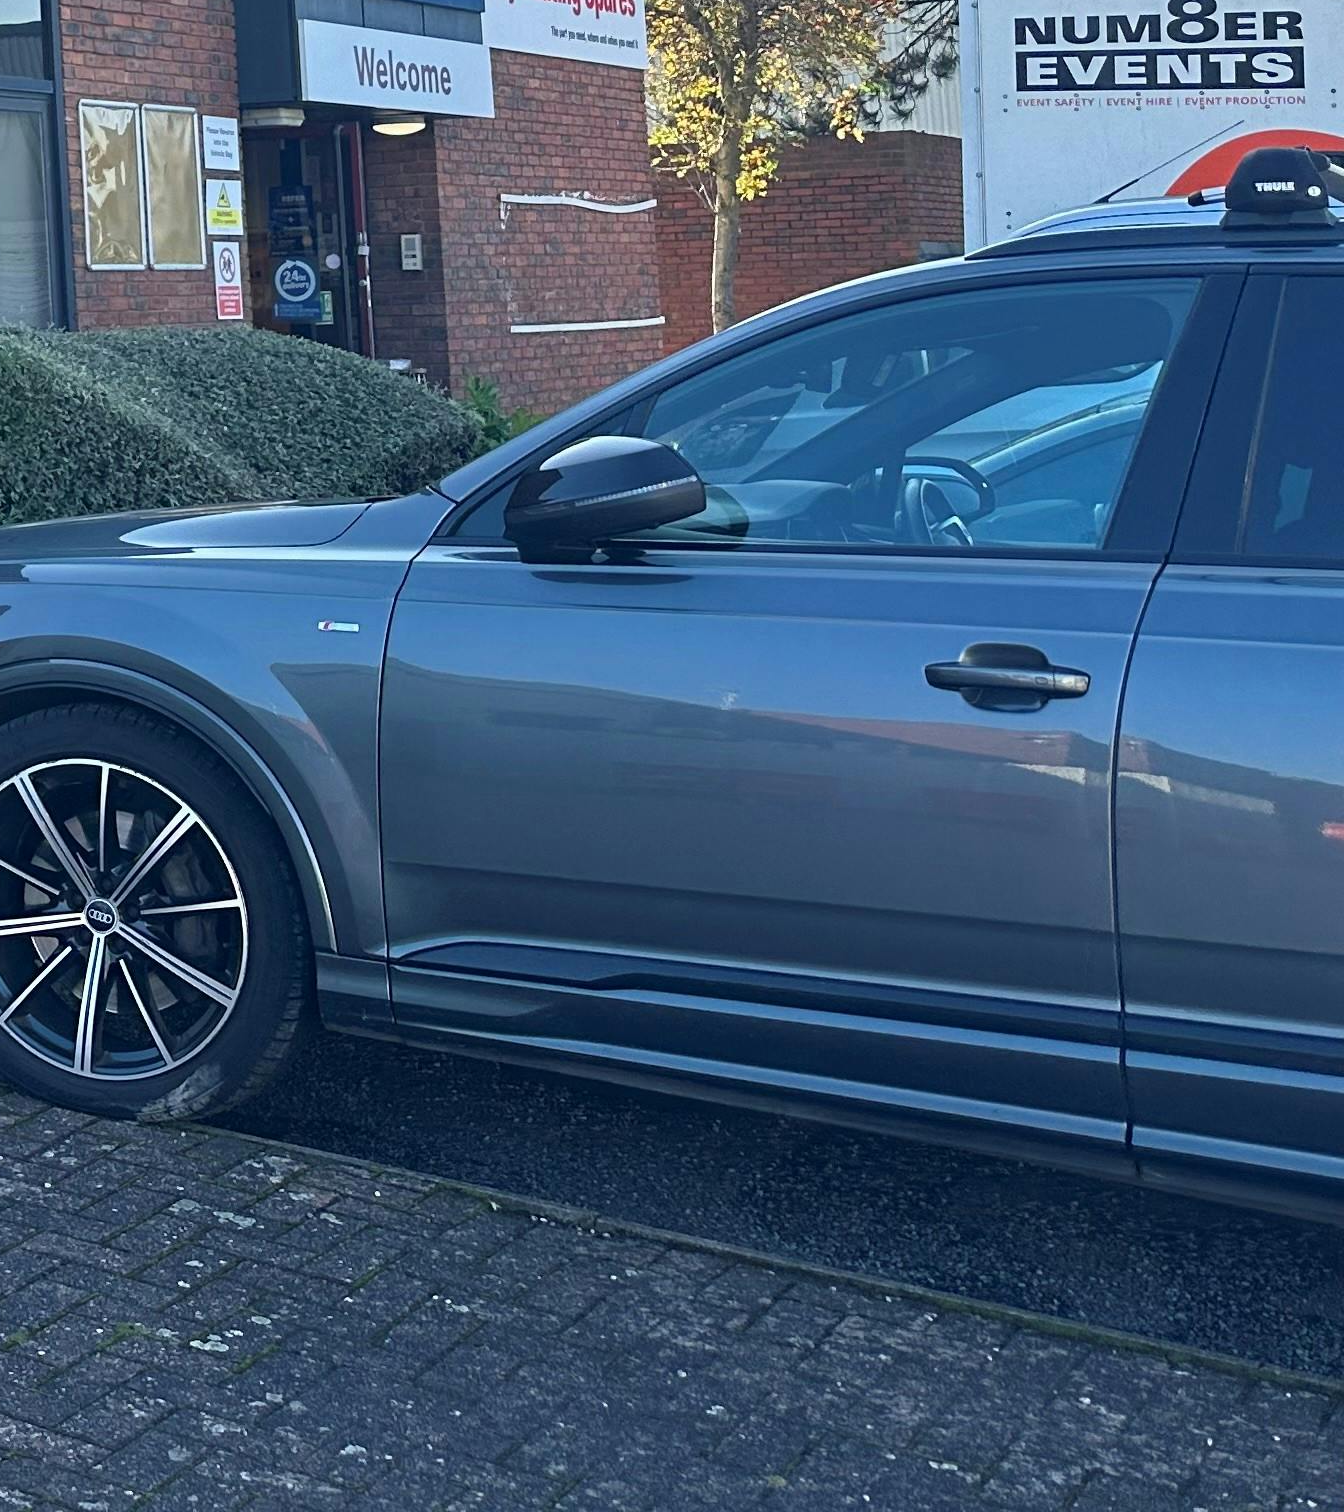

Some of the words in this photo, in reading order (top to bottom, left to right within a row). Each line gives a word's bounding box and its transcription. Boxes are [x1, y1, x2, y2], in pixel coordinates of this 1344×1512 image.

[354, 44, 452, 96] Welcome
[1026, 53, 1294, 85] EVENTS
[1017, 98, 1051, 107] EVENT
[1054, 97, 1095, 107] SAFETY
[1106, 96, 1141, 106] EVENT
[1146, 96, 1173, 106] HIRE
[1185, 96, 1222, 106] EVENT
[1225, 95, 1306, 106] PRODUCTION
[1254, 182, 1295, 192] THULE
